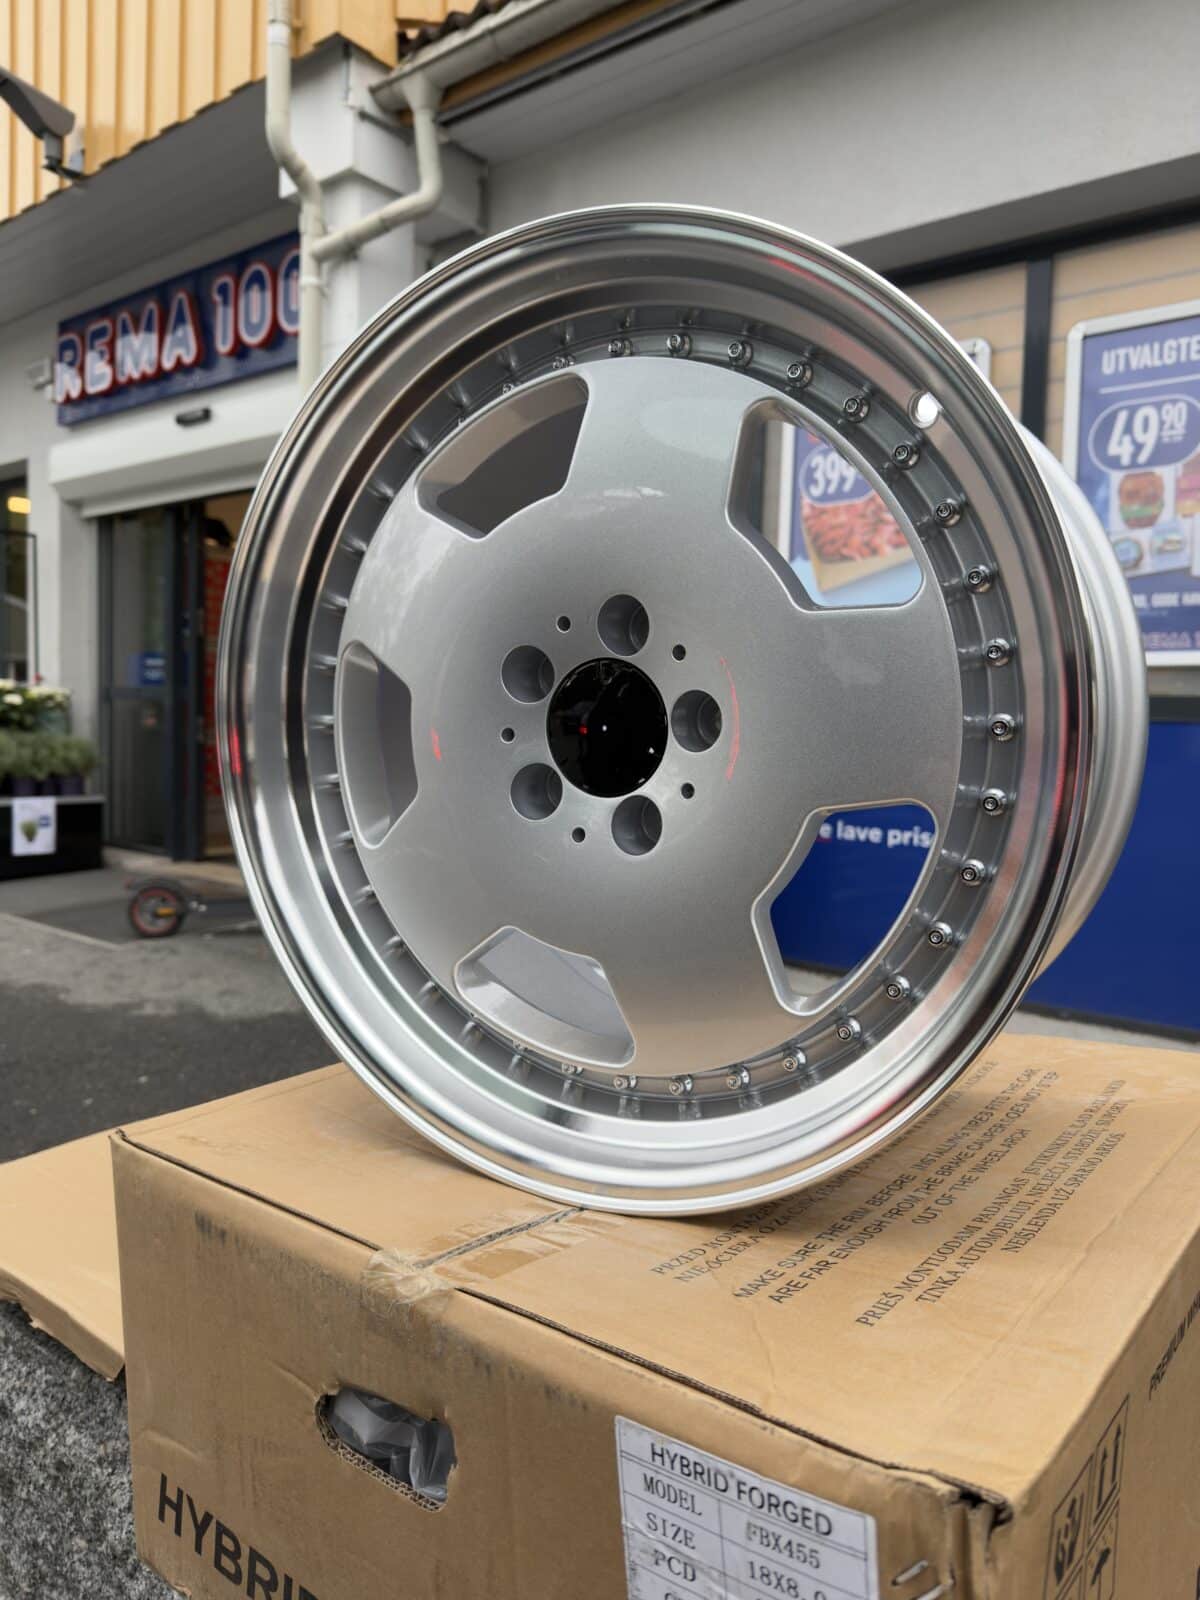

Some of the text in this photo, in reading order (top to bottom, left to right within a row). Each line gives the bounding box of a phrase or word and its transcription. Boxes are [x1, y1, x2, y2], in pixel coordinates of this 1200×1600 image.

[54, 246, 301, 405] REMA 100
[1101, 334, 1200, 375] UTVALGTE
[836, 819, 883, 844] lave
[887, 825, 932, 849] pris
[912, 1206, 943, 1225] OUT
[935, 1193, 958, 1206] OF
[949, 1174, 979, 1192] THE
[1000, 1201, 1065, 1253] NEIŠLENDA
[1050, 1186, 1075, 1201] UŽ
[1063, 1156, 1103, 1188] SPARNO
[733, 1268, 785, 1297] MAKE
[778, 1241, 824, 1269] SURE
[815, 1221, 851, 1243] THE
[866, 1173, 918, 1207] BEFORE
[768, 1279, 808, 1304] ARE
[800, 1260, 838, 1280] FAR
[828, 1219, 892, 1260] ENOUGH
[881, 1194, 923, 1220] FROM
[912, 1176, 944, 1196] THE
[936, 1151, 975, 1177] BRAKE
[856, 1290, 904, 1328] PRIEŠ
[894, 1224, 983, 1292] MONTUODAMI
[971, 1176, 1030, 1224] PADANGAS
[651, 1247, 706, 1275] PRZED
[914, 1269, 966, 1303] TINKA
[642, 1472, 703, 1517] MODEL
[650, 1442, 833, 1537] HYBRID FORGED
[158, 1472, 319, 1600] HYBRI
[646, 1511, 696, 1550] SIZE
[653, 1548, 697, 1582] PCD
